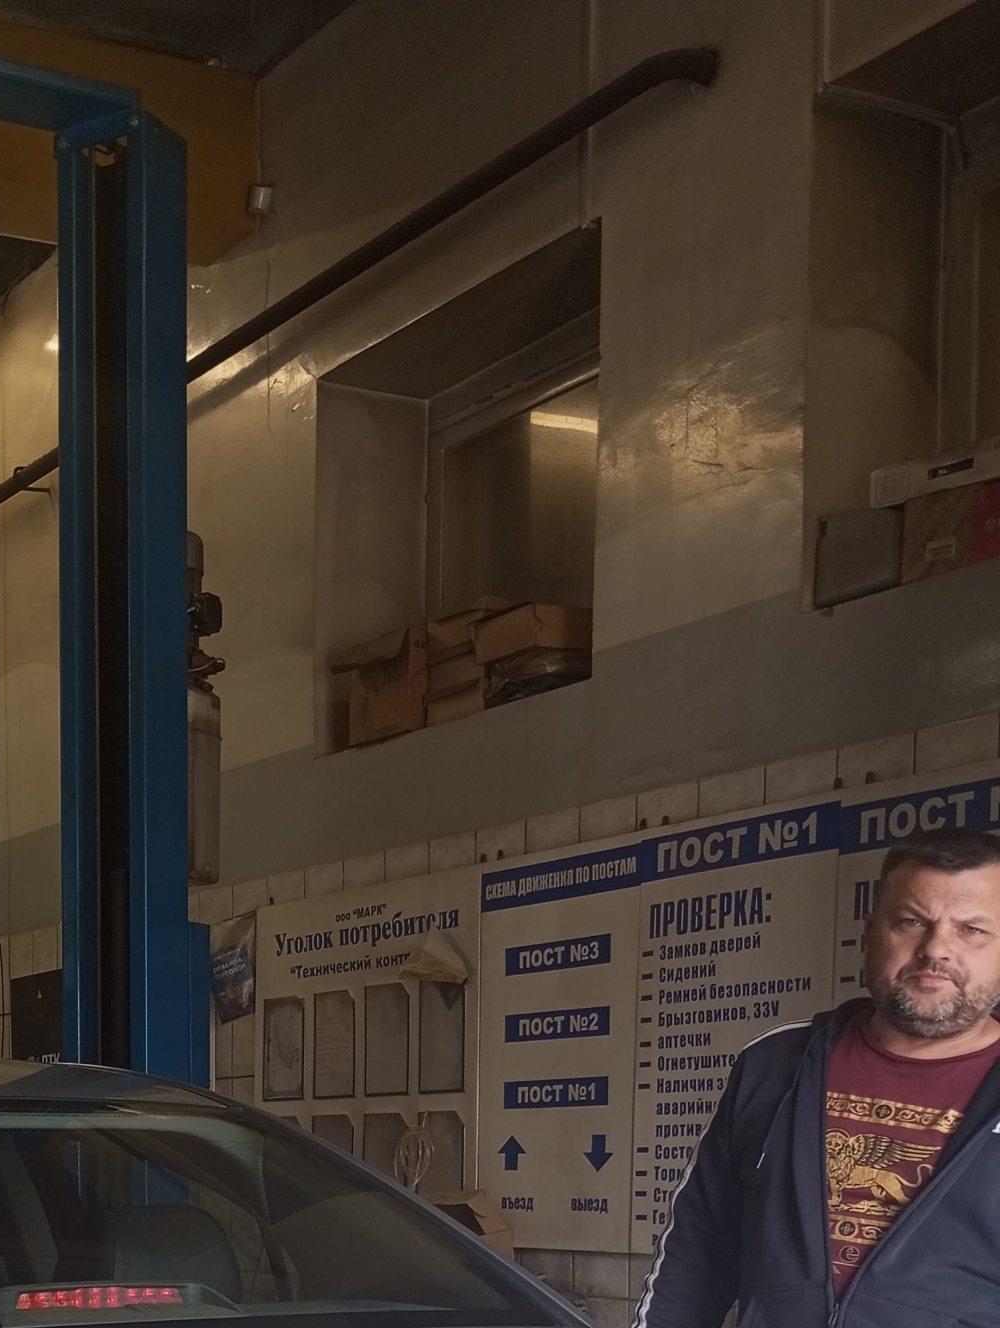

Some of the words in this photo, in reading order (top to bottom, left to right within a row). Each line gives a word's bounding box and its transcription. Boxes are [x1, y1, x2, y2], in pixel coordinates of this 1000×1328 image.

[859, 790, 975, 845] ПОСТ
[657, 826, 748, 873] ПОСТ
[758, 811, 819, 855] №1
[485, 880, 517, 901] СХЕМА
[517, 869, 574, 898] ДВИЖЕНИЯ
[575, 865, 591, 885] ПО
[592, 856, 637, 882] ПОСТАМ
[649, 886, 773, 940] ПРОВЕРКА:
[274, 928, 334, 957] Уголок
[338, 908, 460, 947] потребителя
[518, 945, 565, 970] ПОСТ
[569, 941, 600, 963] №3
[659, 942, 707, 961] Замков
[709, 932, 761, 954] дверей
[659, 960, 716, 983] Сидений
[658, 982, 706, 1005] Ремней
[709, 976, 812, 999] безопасности
[518, 1016, 565, 1037] ПОСТ
[569, 1012, 599, 1033] №2
[658, 1005, 750, 1029] Брызговиков,
[658, 1032, 711, 1049] аптечки
[657, 1053, 737, 1072] Огнетушите
[517, 1084, 564, 1104] ПОСТ
[568, 1082, 597, 1102] №1
[656, 1078, 713, 1094] Наличия
[656, 1123, 702, 1139] против
[655, 1144, 693, 1160] Состо
[654, 1166, 685, 1182] Торм
[501, 1196, 534, 1212] въезд
[570, 1197, 608, 1214] выезд
